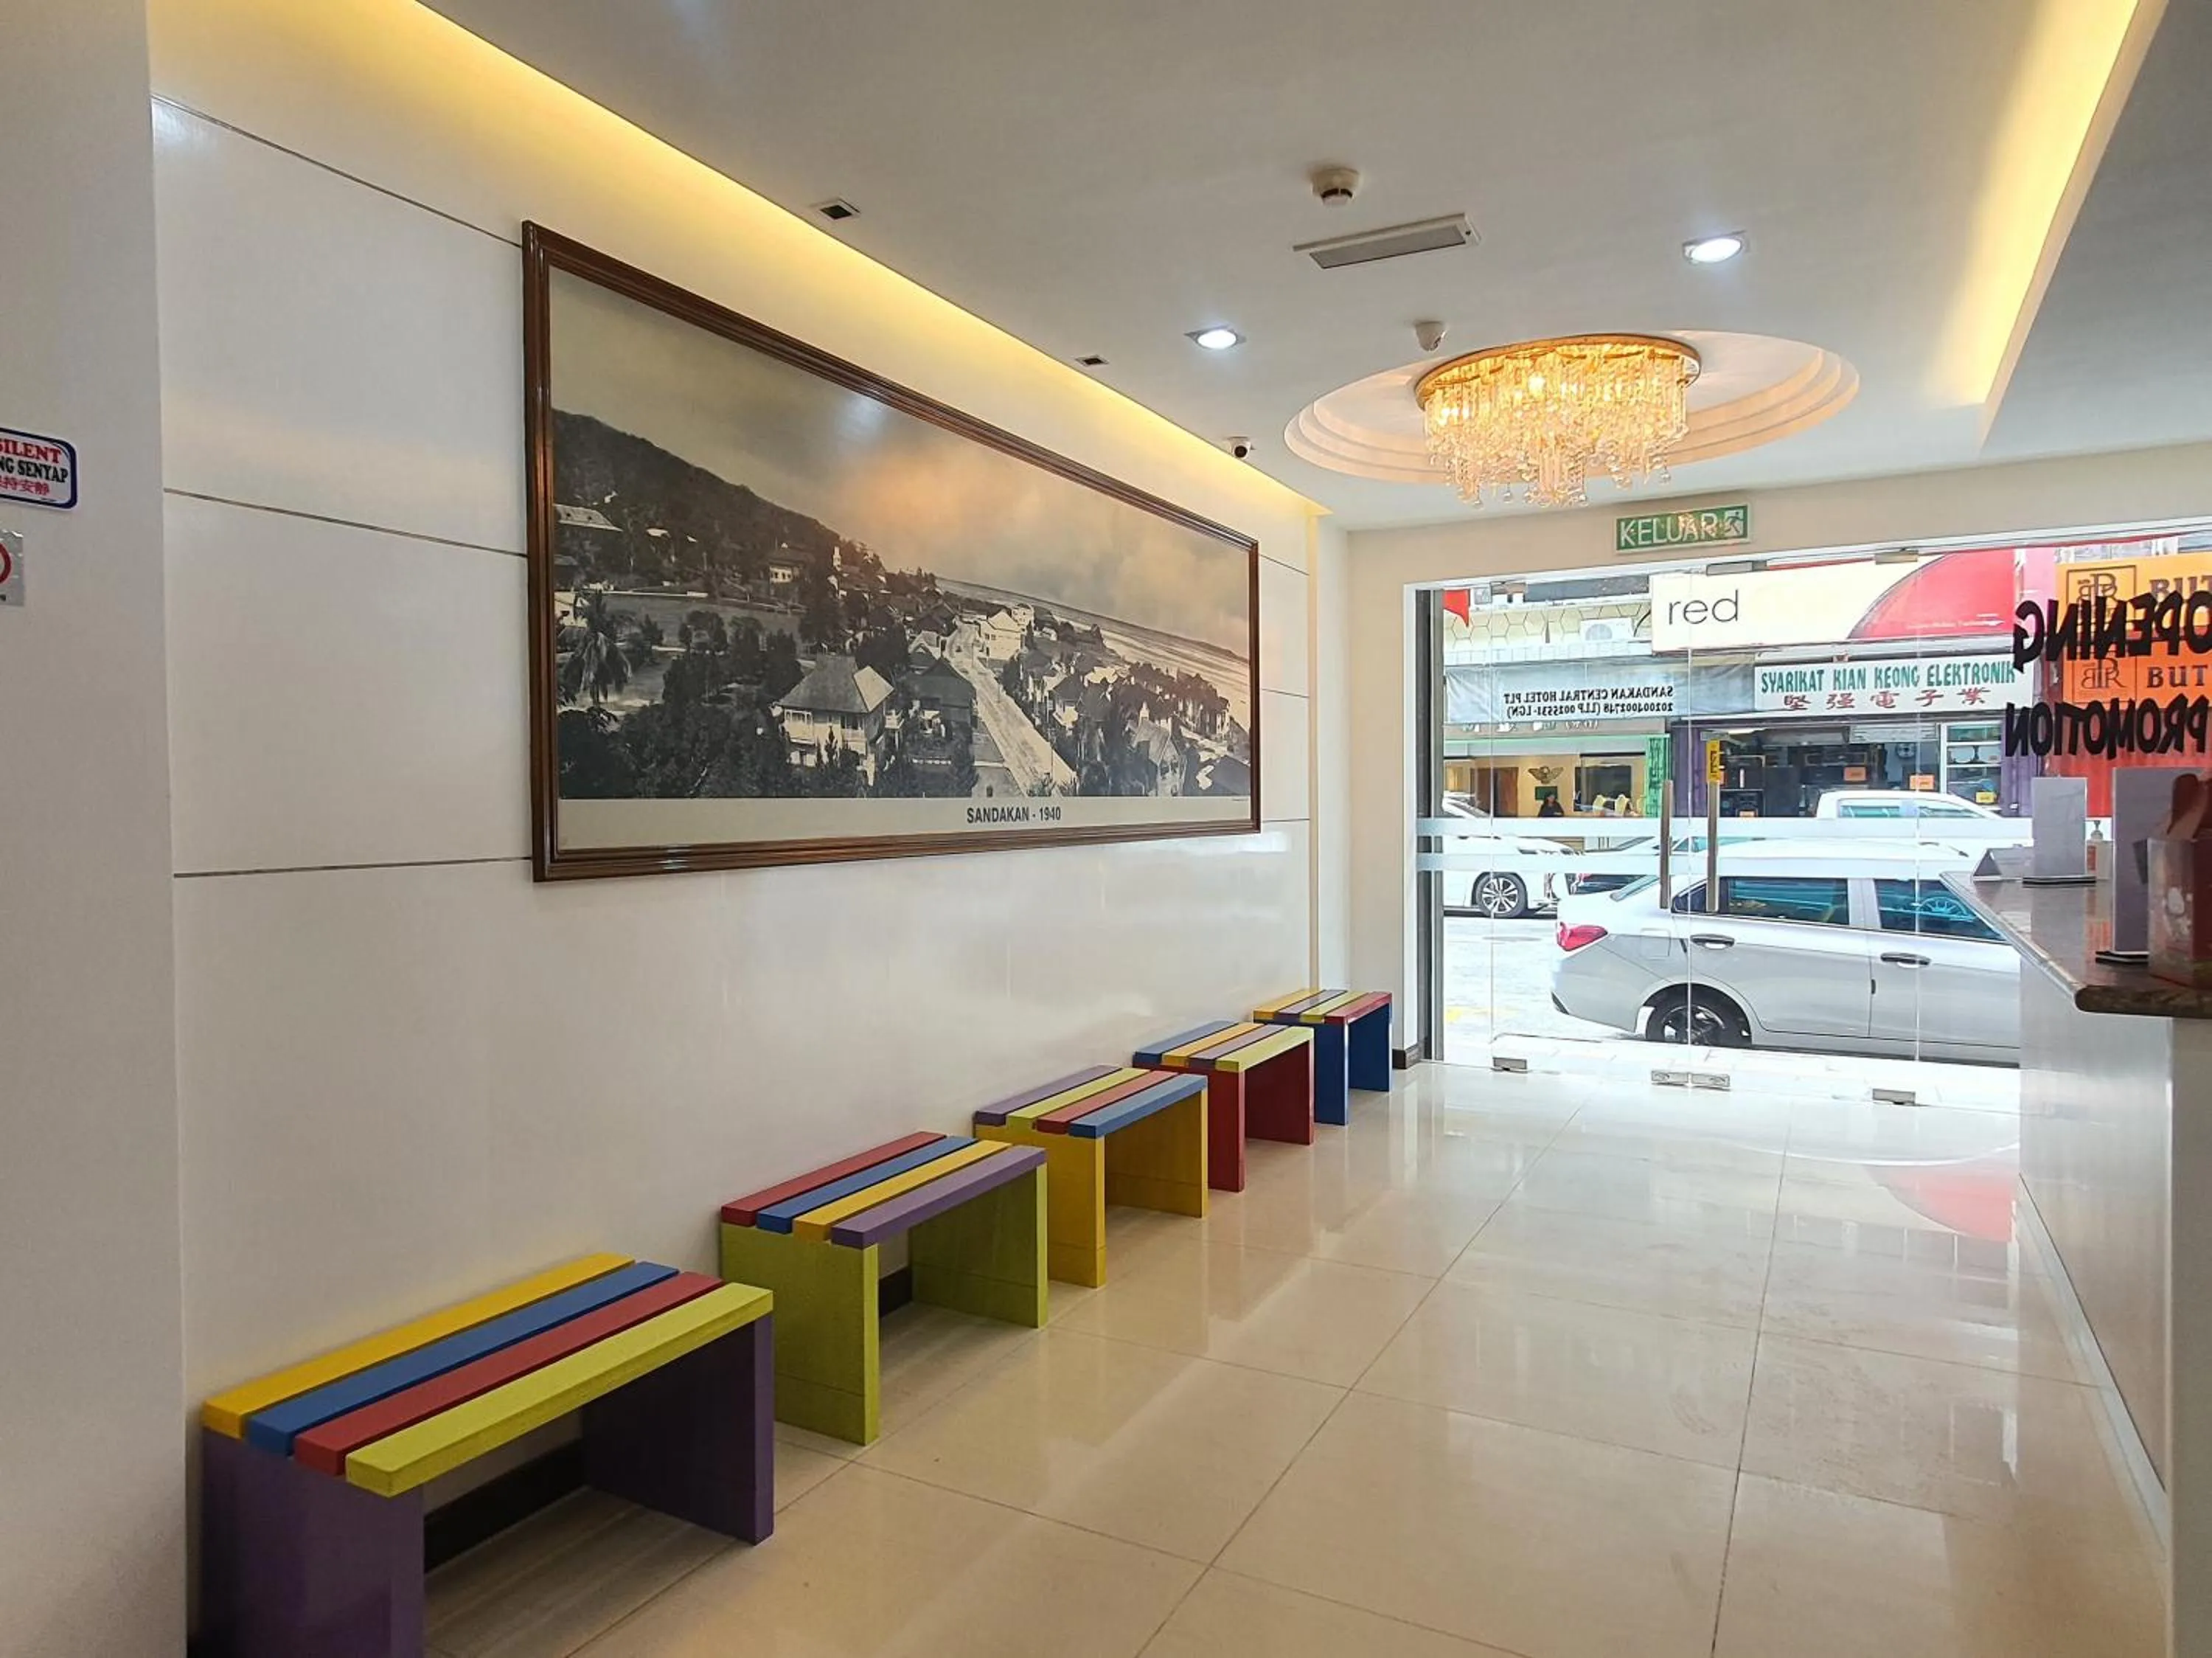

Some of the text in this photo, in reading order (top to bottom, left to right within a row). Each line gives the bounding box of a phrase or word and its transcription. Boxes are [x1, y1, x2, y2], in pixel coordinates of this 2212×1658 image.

[18, 459, 69, 482] SENYAP
[1620, 513, 1717, 547] KELUAR
[1669, 589, 1738, 625] red
[1761, 661, 2016, 693] SYARIKAT KIAN KEONG ELEKTRONIK
[967, 806, 1029, 824] SANDAKAN
[1039, 806, 1061, 821] 1940
